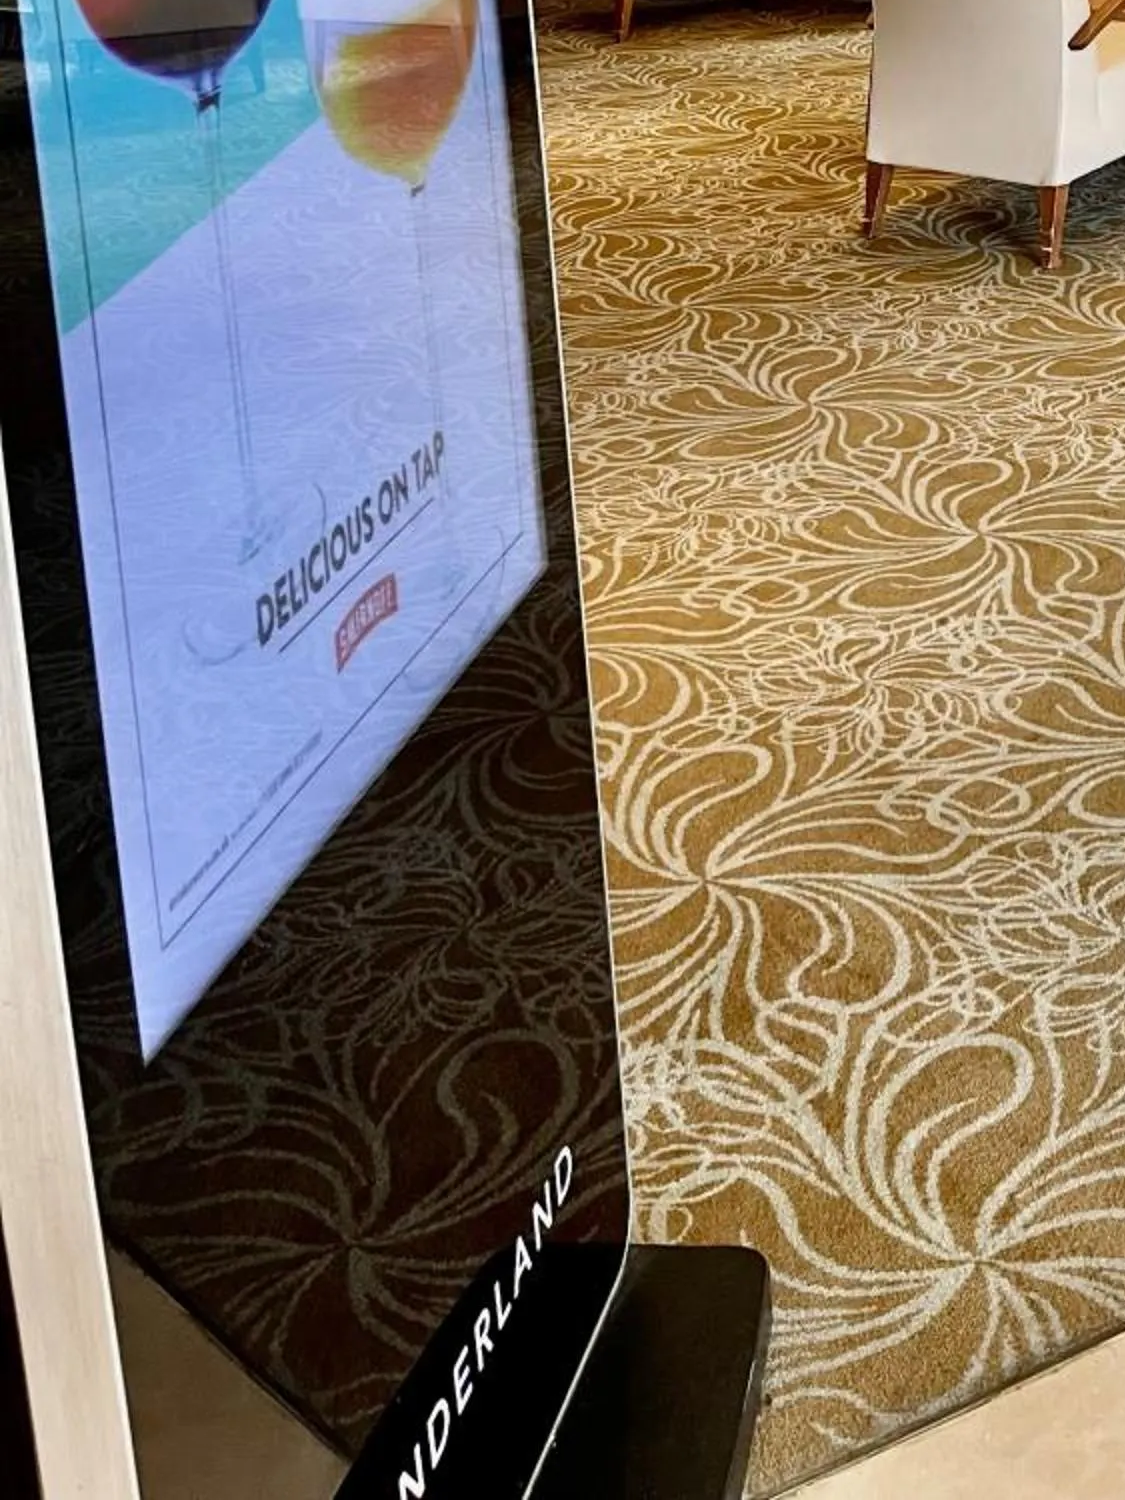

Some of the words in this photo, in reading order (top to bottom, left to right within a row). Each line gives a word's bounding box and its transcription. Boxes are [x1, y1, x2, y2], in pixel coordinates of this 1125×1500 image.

[256, 496, 375, 648] DELICIOUS
[378, 463, 409, 525] ON
[412, 430, 445, 493] TAP
